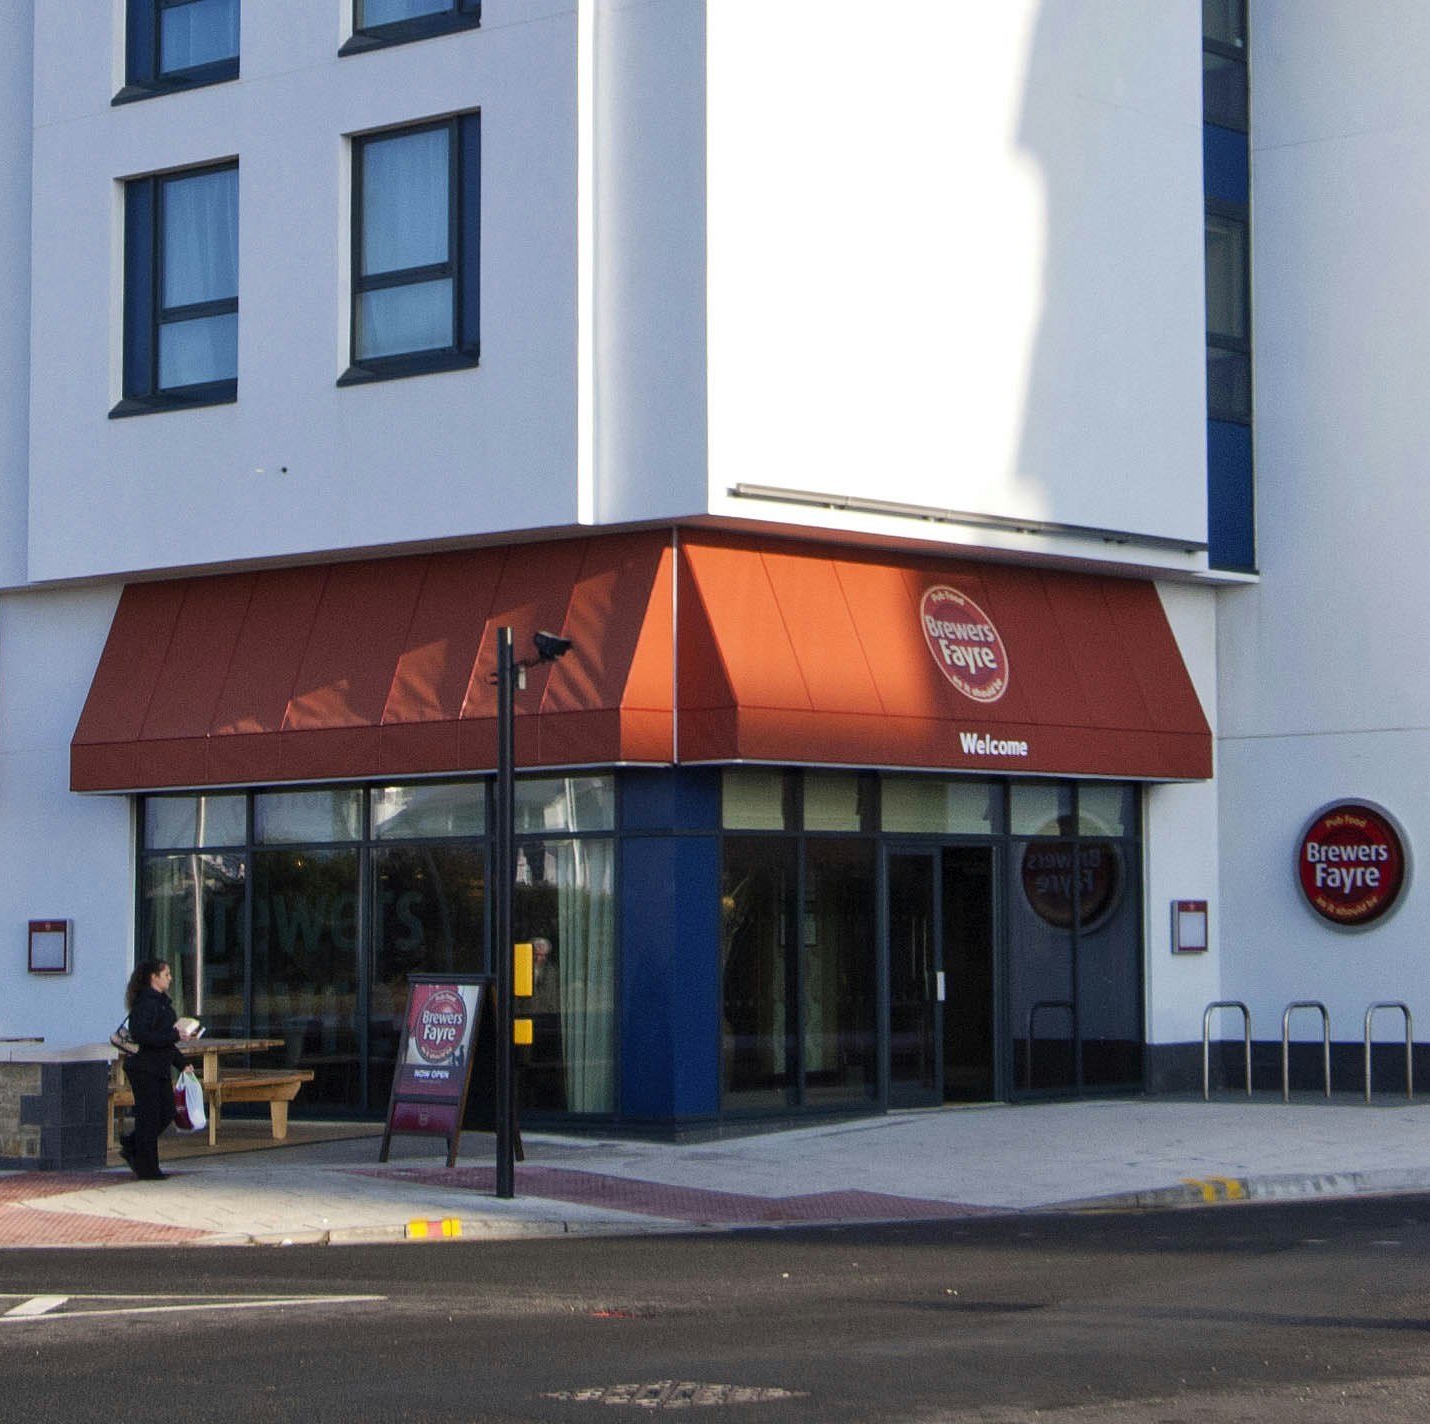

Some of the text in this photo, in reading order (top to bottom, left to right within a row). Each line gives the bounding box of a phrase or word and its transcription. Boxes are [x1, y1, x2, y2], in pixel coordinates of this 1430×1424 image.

[924, 615, 995, 643] Brewers
[939, 639, 997, 675] Fayre
[960, 732, 1028, 756] Welcome
[1306, 842, 1388, 862] Brewers
[1315, 863, 1380, 894] Fayre
[422, 1010, 463, 1025] Brewers
[423, 1025, 456, 1045] Fayre
